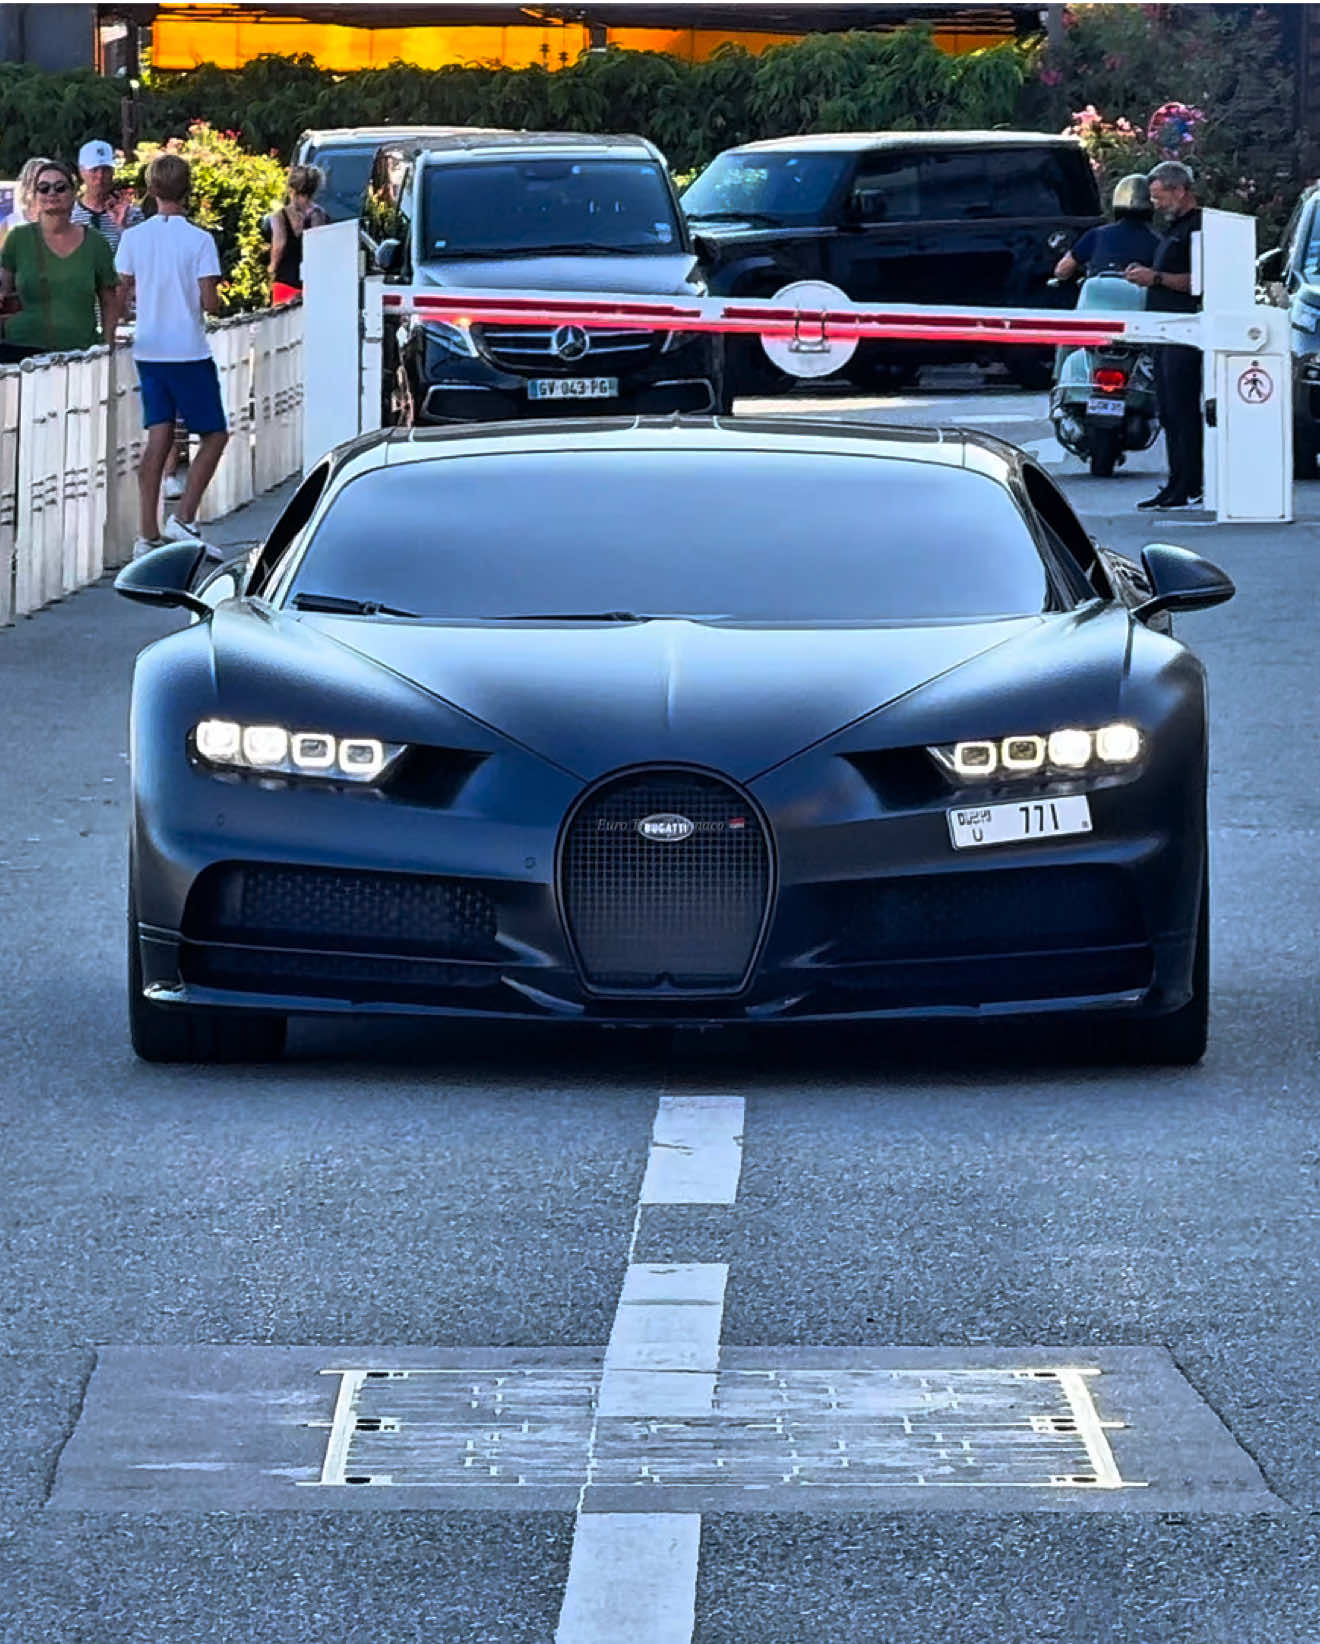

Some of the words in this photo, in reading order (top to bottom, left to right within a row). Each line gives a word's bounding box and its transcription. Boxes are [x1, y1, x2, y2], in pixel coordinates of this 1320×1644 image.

[1019, 803, 1060, 834] 771
[644, 822, 689, 834] BUGATTI
[972, 827, 984, 842] U
